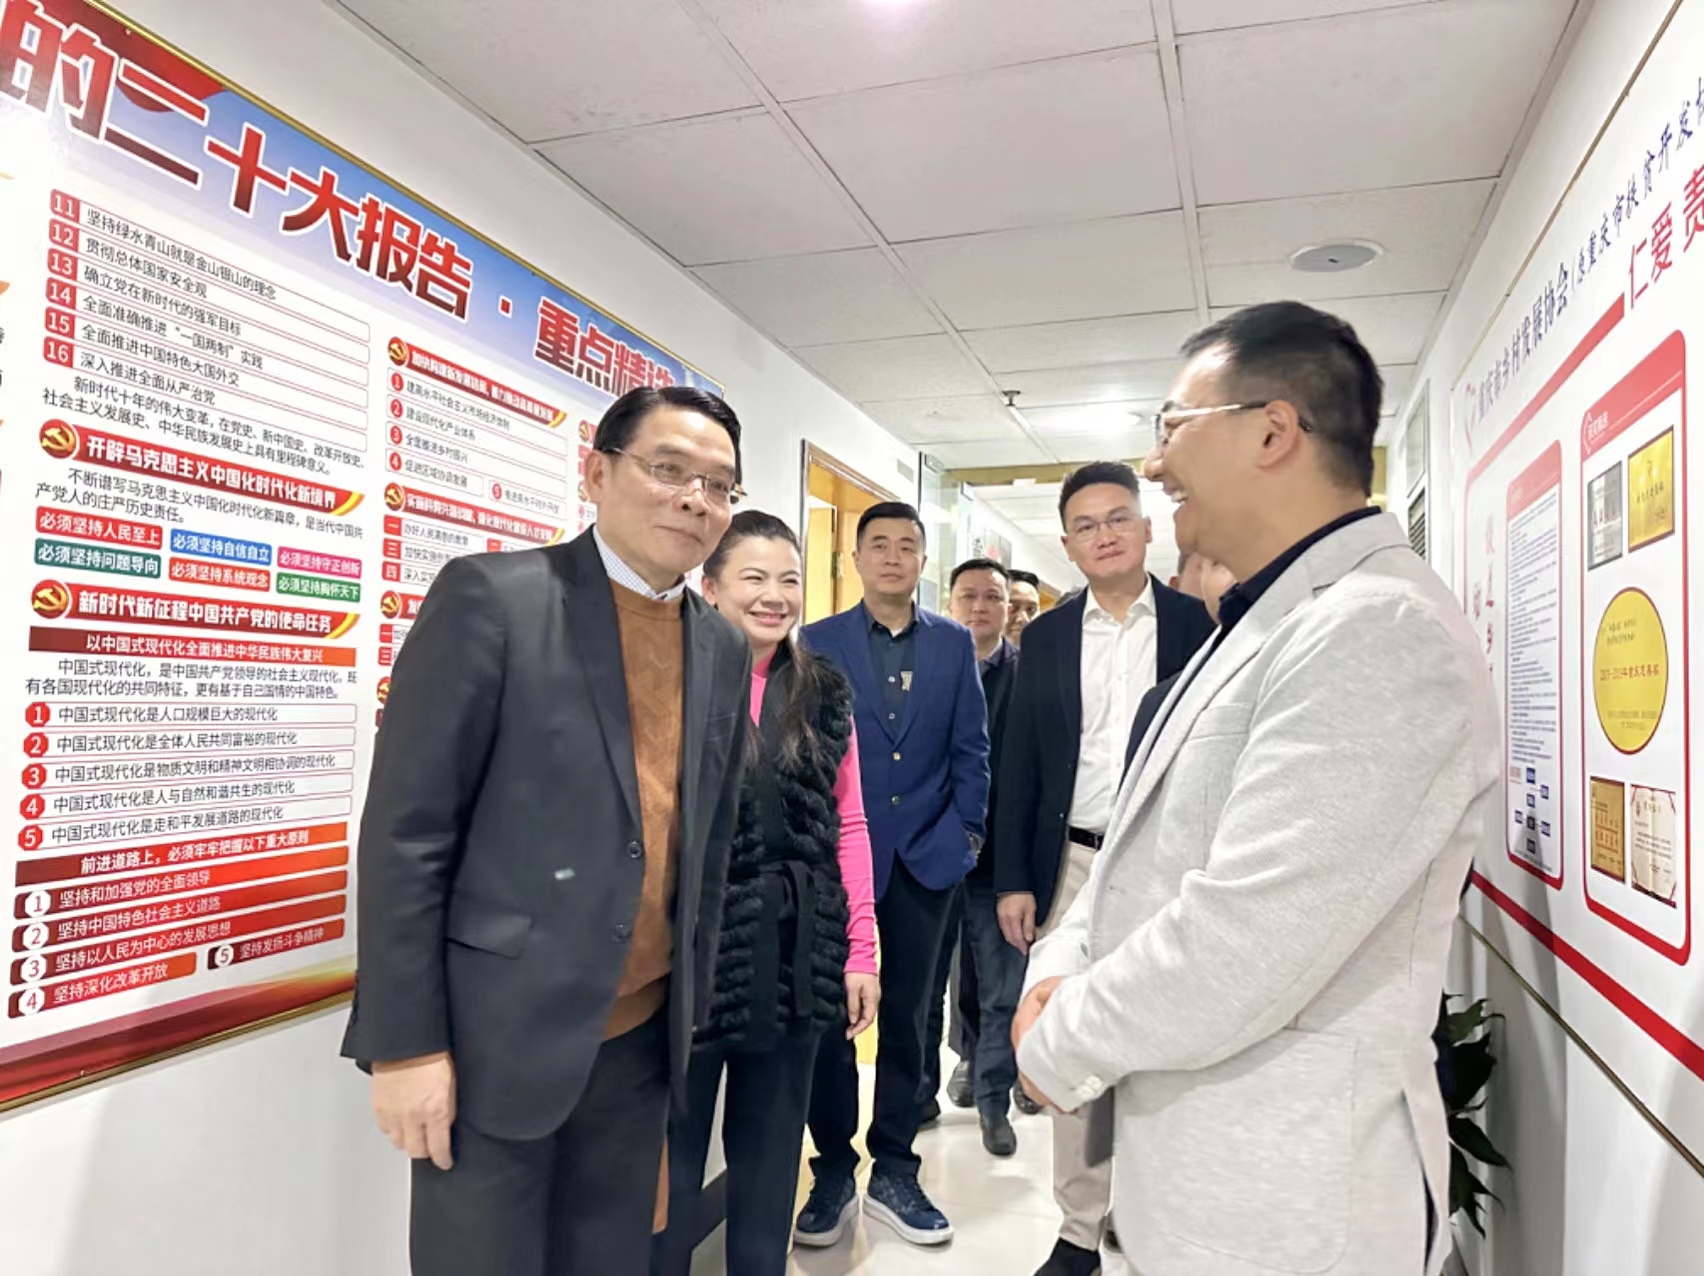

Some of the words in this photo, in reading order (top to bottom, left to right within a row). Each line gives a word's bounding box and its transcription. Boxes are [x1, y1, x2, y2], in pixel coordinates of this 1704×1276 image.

[54, 199, 76, 219] 11
[52, 225, 75, 248] 12
[86, 238, 207, 298] 贯彻总体国家安全观
[49, 281, 72, 302] 14
[51, 253, 74, 275] 13
[84, 265, 242, 337] 确立党在新时代的强军目标
[47, 311, 71, 335] 15
[82, 324, 240, 387] 全面推进中国特色大国外交
[46, 341, 70, 364] 16
[81, 352, 215, 405] 深入推进全面从严治党
[87, 435, 336, 509] 开辟马克思主义中国化时代化新境界
[39, 511, 160, 545] 必须坚持人民至上
[38, 543, 158, 575] 必须坚持问题导向
[172, 532, 270, 563] 必须坚持自信自立
[279, 553, 361, 576] 必须坚持守正创新
[171, 562, 268, 588] 必须坚持系统观念
[278, 577, 360, 600] 必须坚持胸怀天下
[78, 590, 332, 633] 新时代新征程中国共产党的使命任务
[85, 634, 324, 663] 以中国式现代化全面推进中华民族伟大复兴
[32, 705, 43, 723] 1
[58, 705, 278, 723] 中国式现代化是人口规模巨大的现代化
[30, 736, 41, 754] 2
[57, 732, 298, 753] 中国式现代化是全体人民共同富裕的现代化
[28, 767, 40, 786] 3
[55, 754, 336, 783] 中国式现代化是物质文明和精神文明相协调的现代化
[26, 798, 38, 816] 4
[54, 780, 295, 813] 中国式现代化是人与自然和谐共生的现代化
[24, 828, 36, 847] 5
[52, 806, 284, 843] 中国式现代化是走和平发展道路的现代化
[33, 895, 43, 913] 1
[59, 869, 210, 908] 坚持和加强党的全面领导
[31, 927, 41, 945] 2
[57, 896, 221, 940] 坚持中国特色社会主义道路
[28, 960, 40, 977] 3
[55, 921, 231, 972] 坚持以人民为中心的发展思想
[220, 949, 229, 964] 5
[26, 992, 37, 1010] 4
[53, 963, 168, 1004] 坚持深化改革开放
